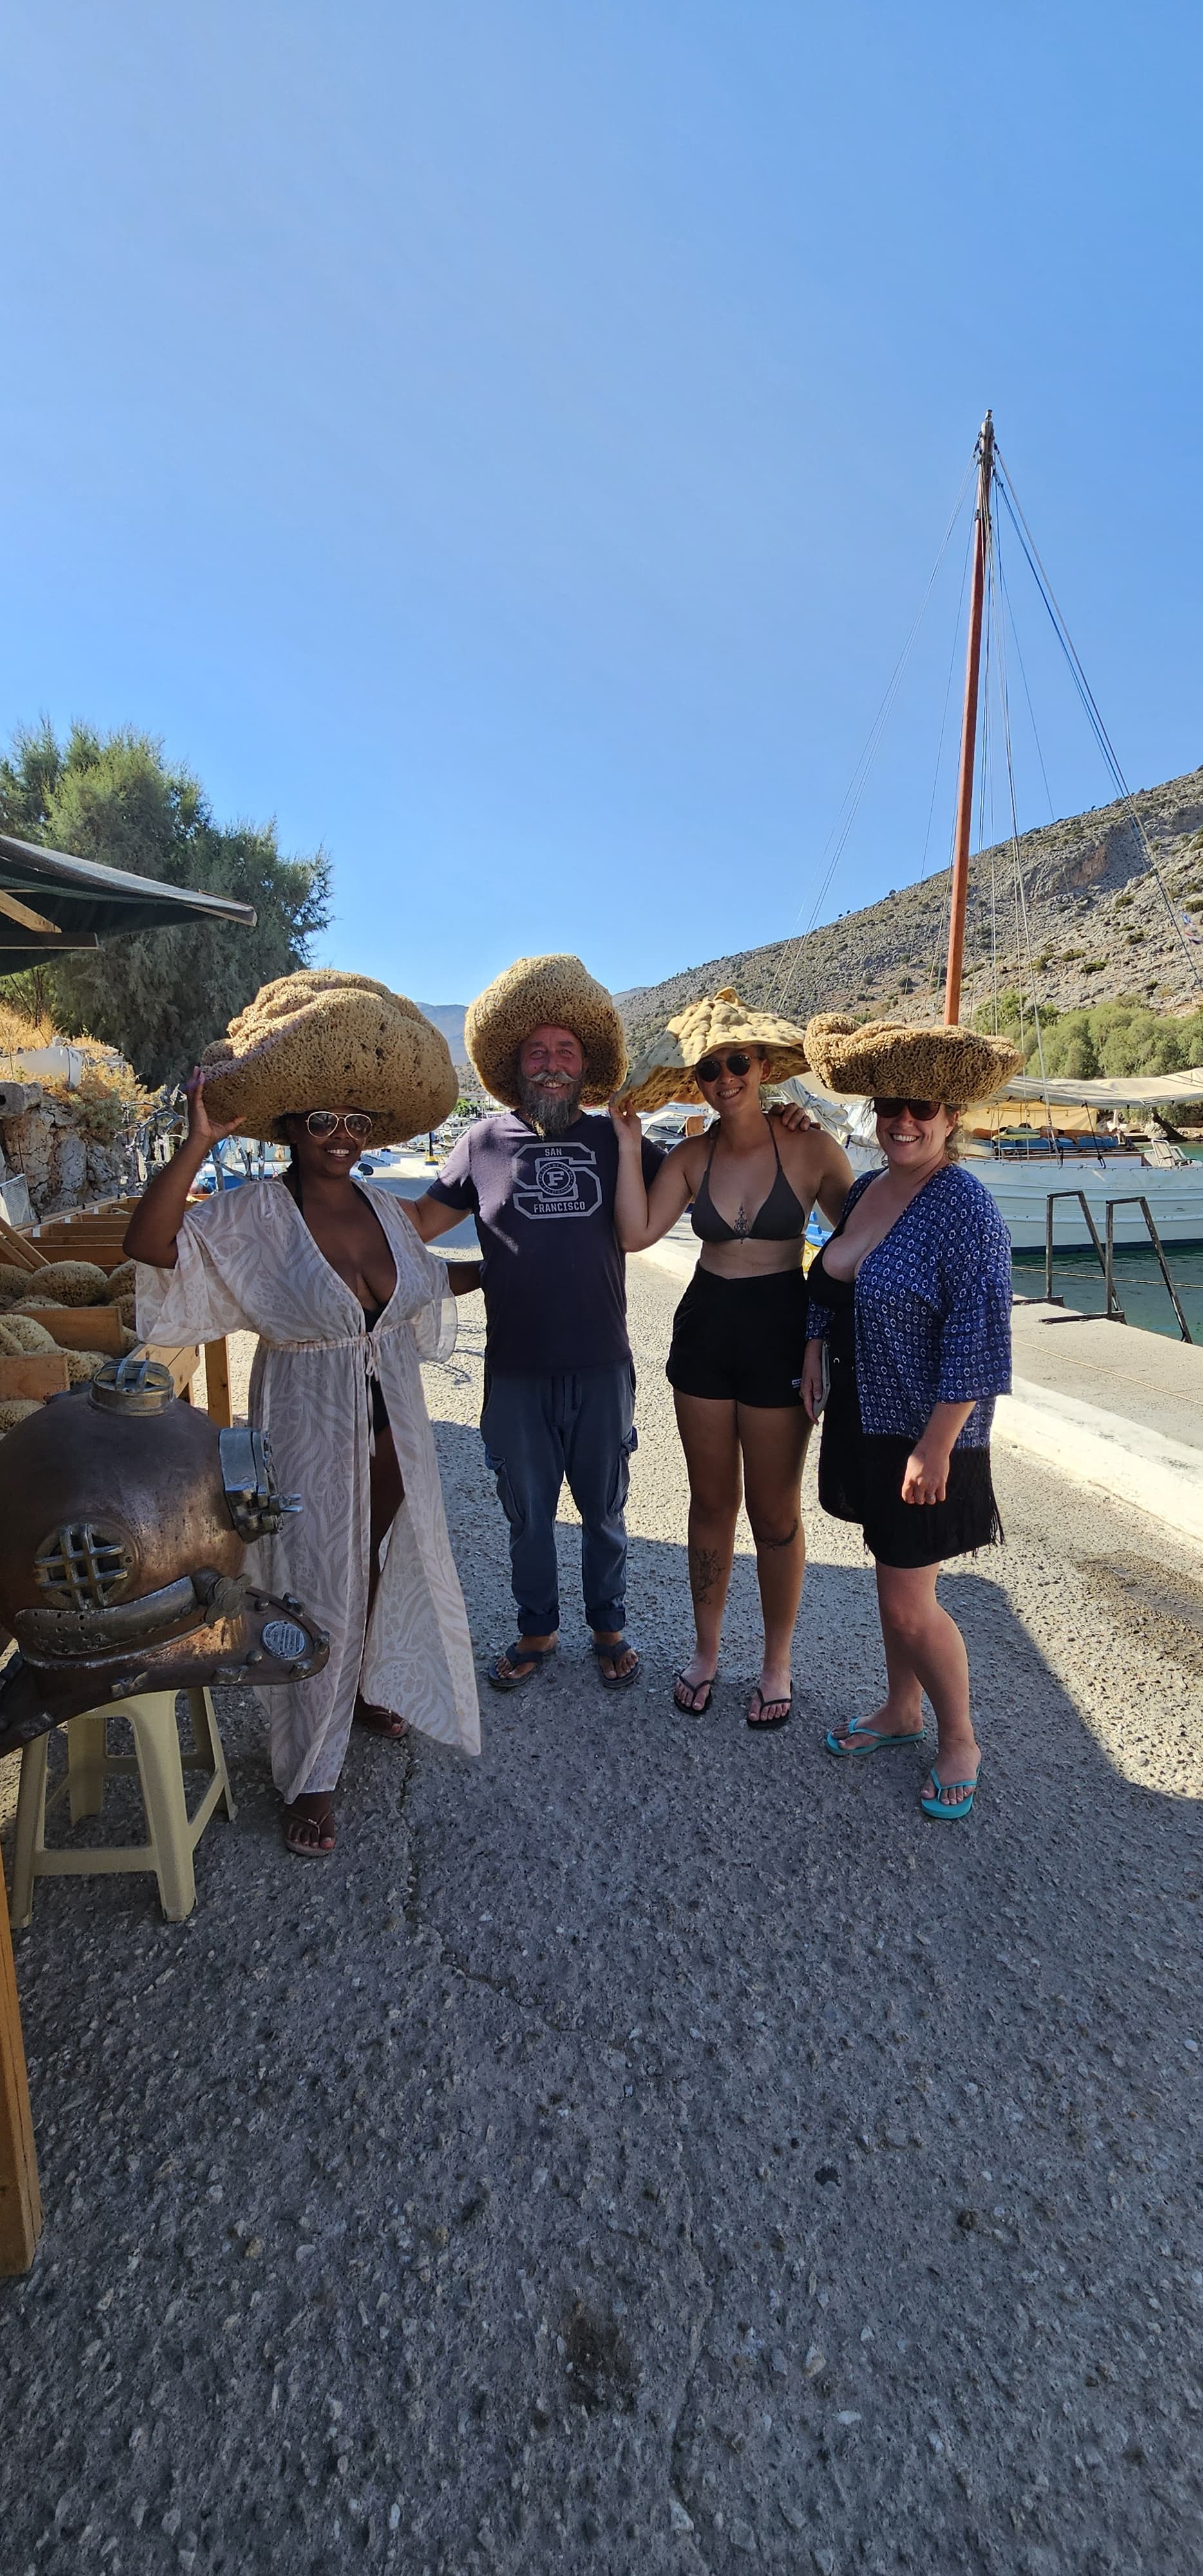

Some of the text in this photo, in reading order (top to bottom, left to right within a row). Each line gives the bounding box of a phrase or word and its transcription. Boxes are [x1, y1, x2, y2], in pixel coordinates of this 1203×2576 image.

[544, 1148, 562, 1157] SAN
[546, 1171, 565, 1186] F
[533, 1201, 585, 1213] FRANCISCO
